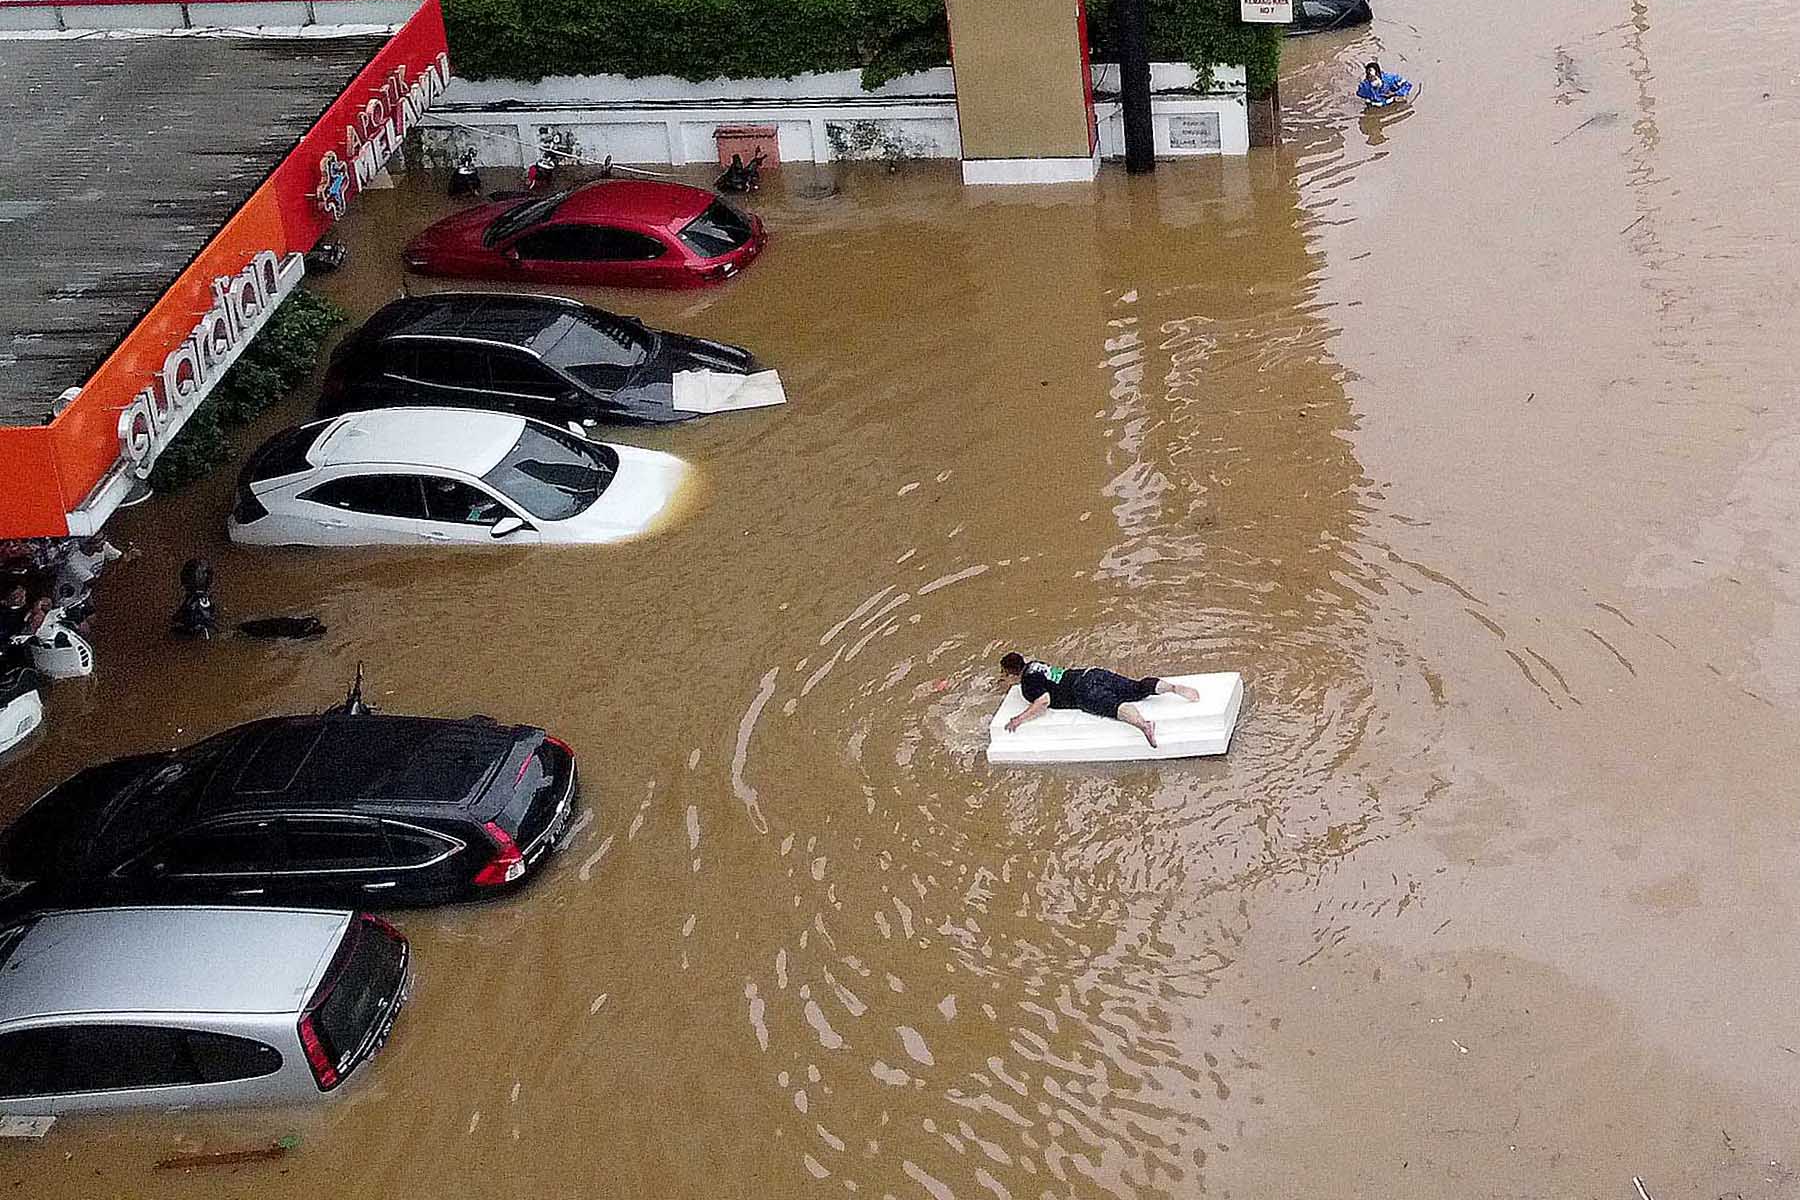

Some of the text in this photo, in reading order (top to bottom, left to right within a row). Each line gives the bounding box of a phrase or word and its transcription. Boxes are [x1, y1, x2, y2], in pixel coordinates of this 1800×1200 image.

[346, 64, 410, 157] APOTIK
[352, 52, 450, 193] MELAWAI
[117, 249, 279, 480] guardian
